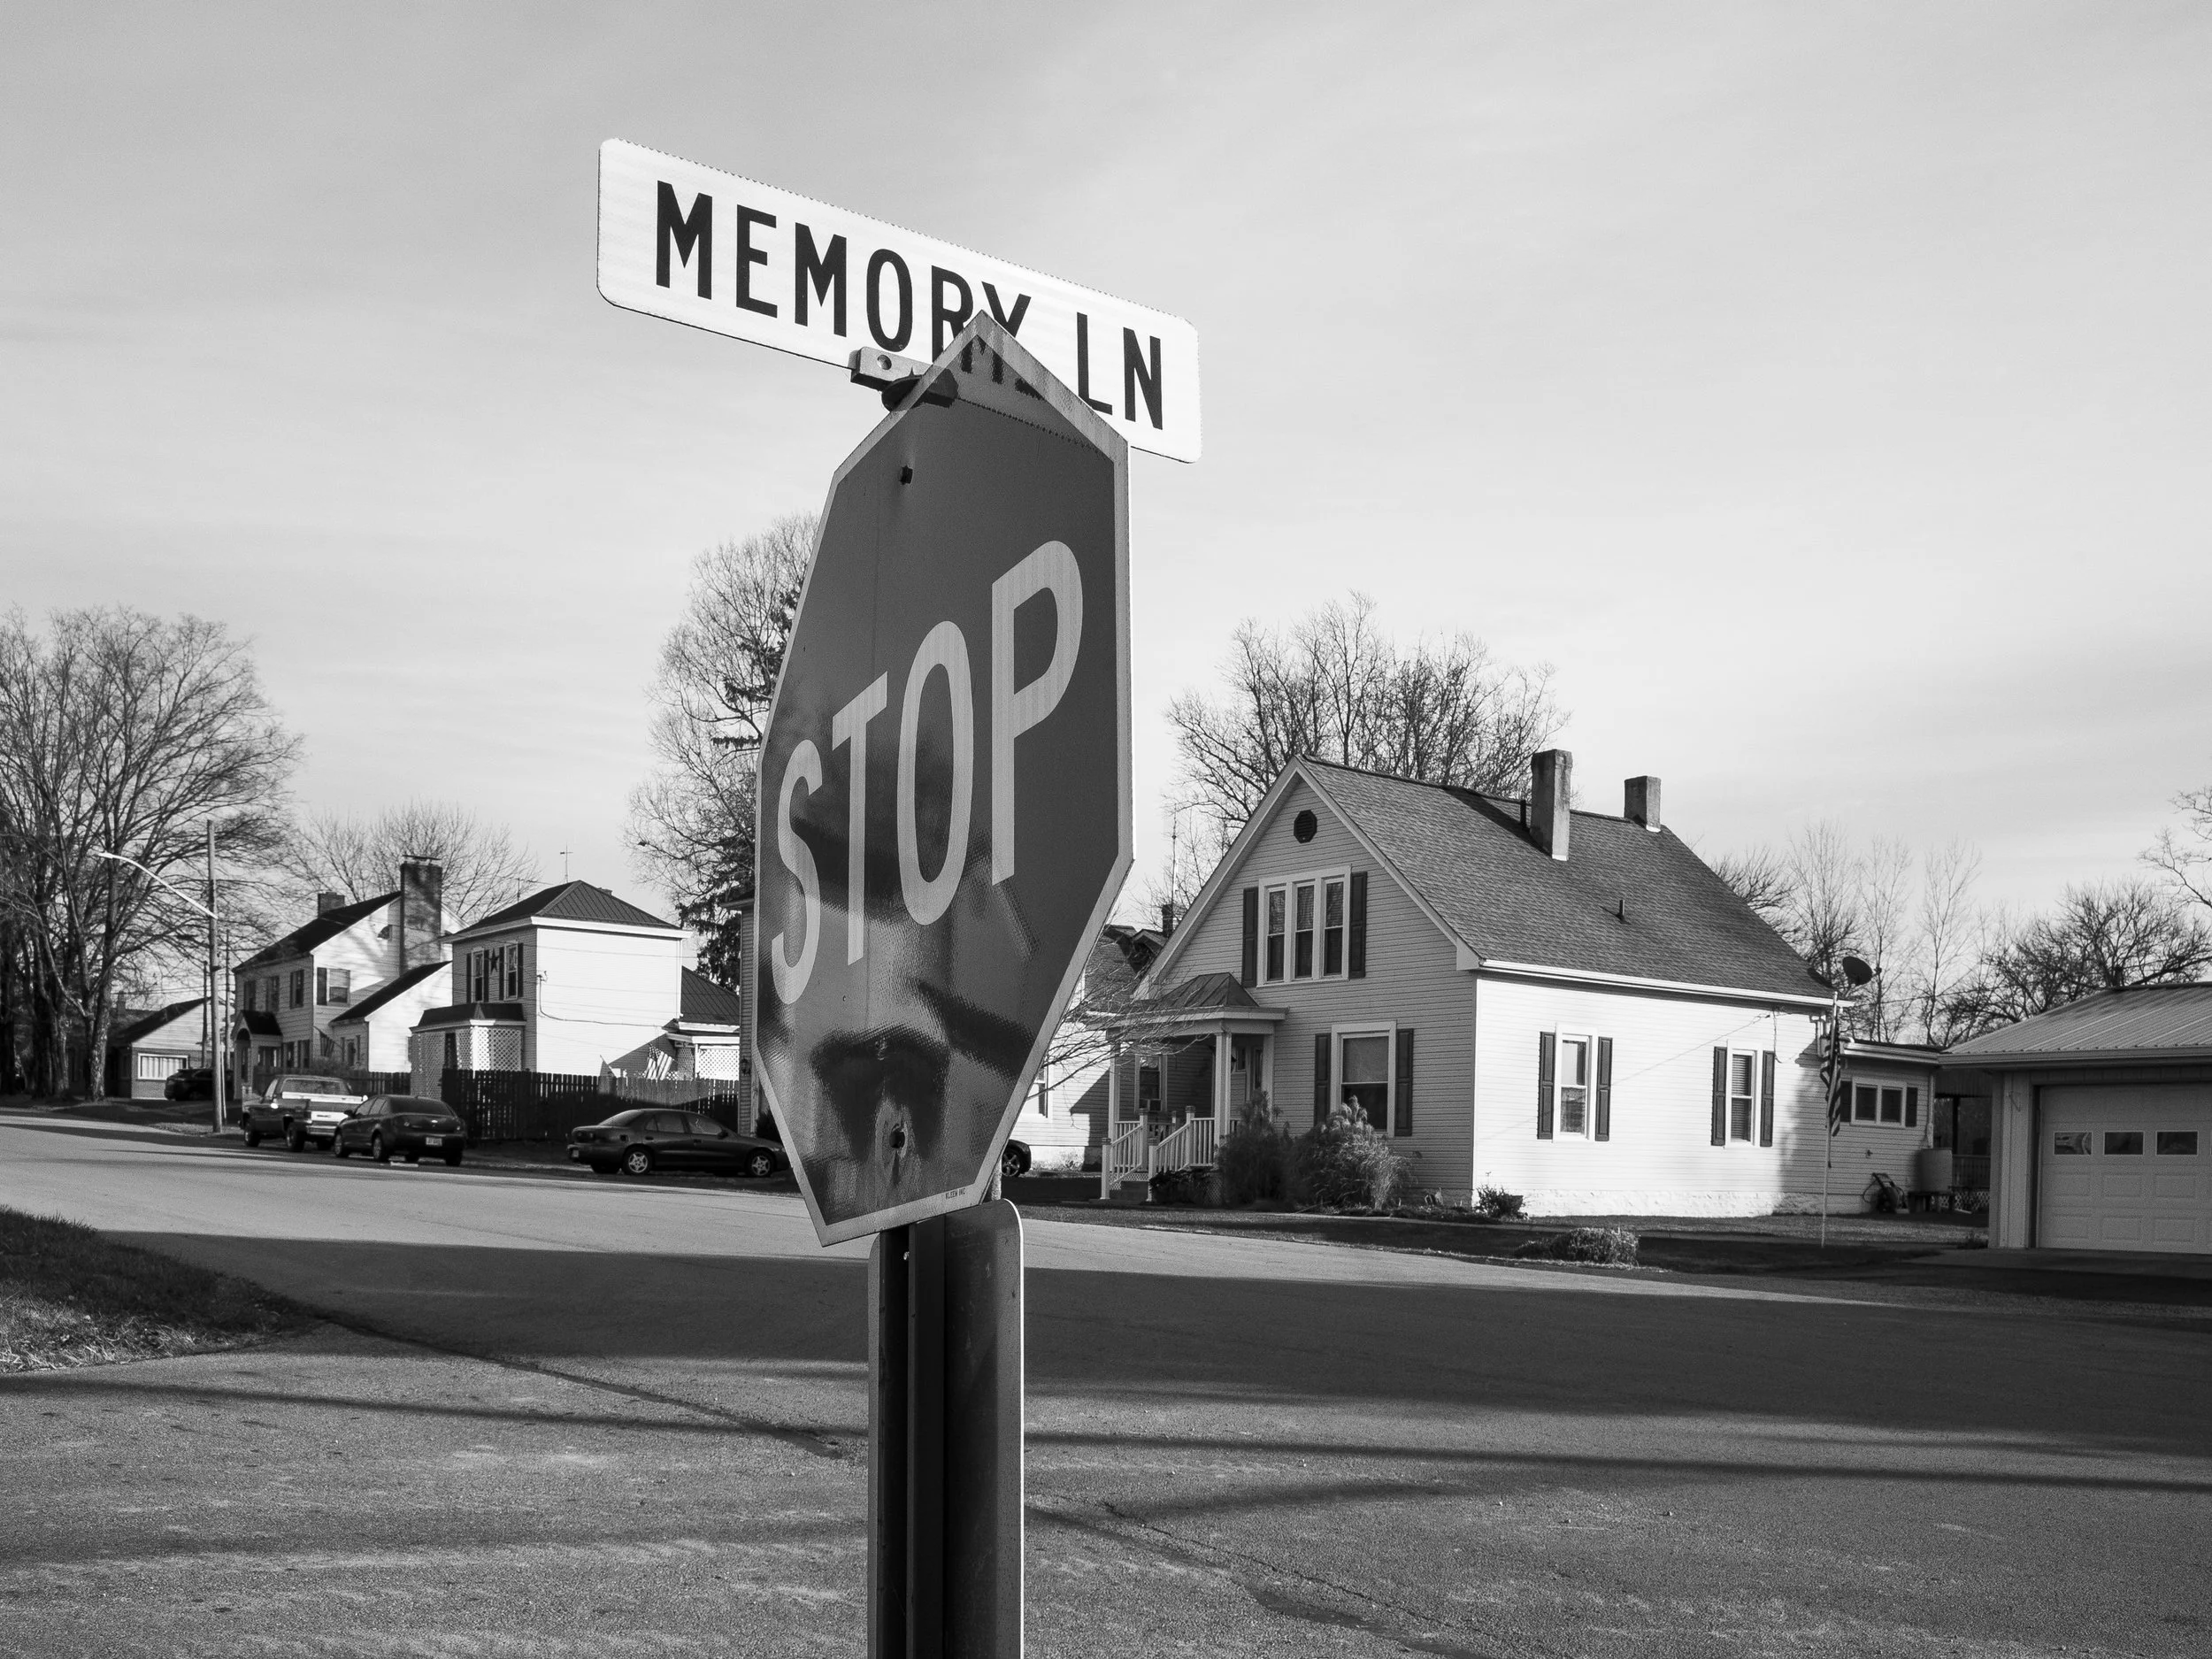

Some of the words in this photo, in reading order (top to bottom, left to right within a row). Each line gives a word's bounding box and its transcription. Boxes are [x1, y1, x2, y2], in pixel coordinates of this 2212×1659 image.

[656, 179, 1032, 364] MEMORY
[1077, 311, 1164, 431] LN
[772, 540, 1084, 1005] STOP
